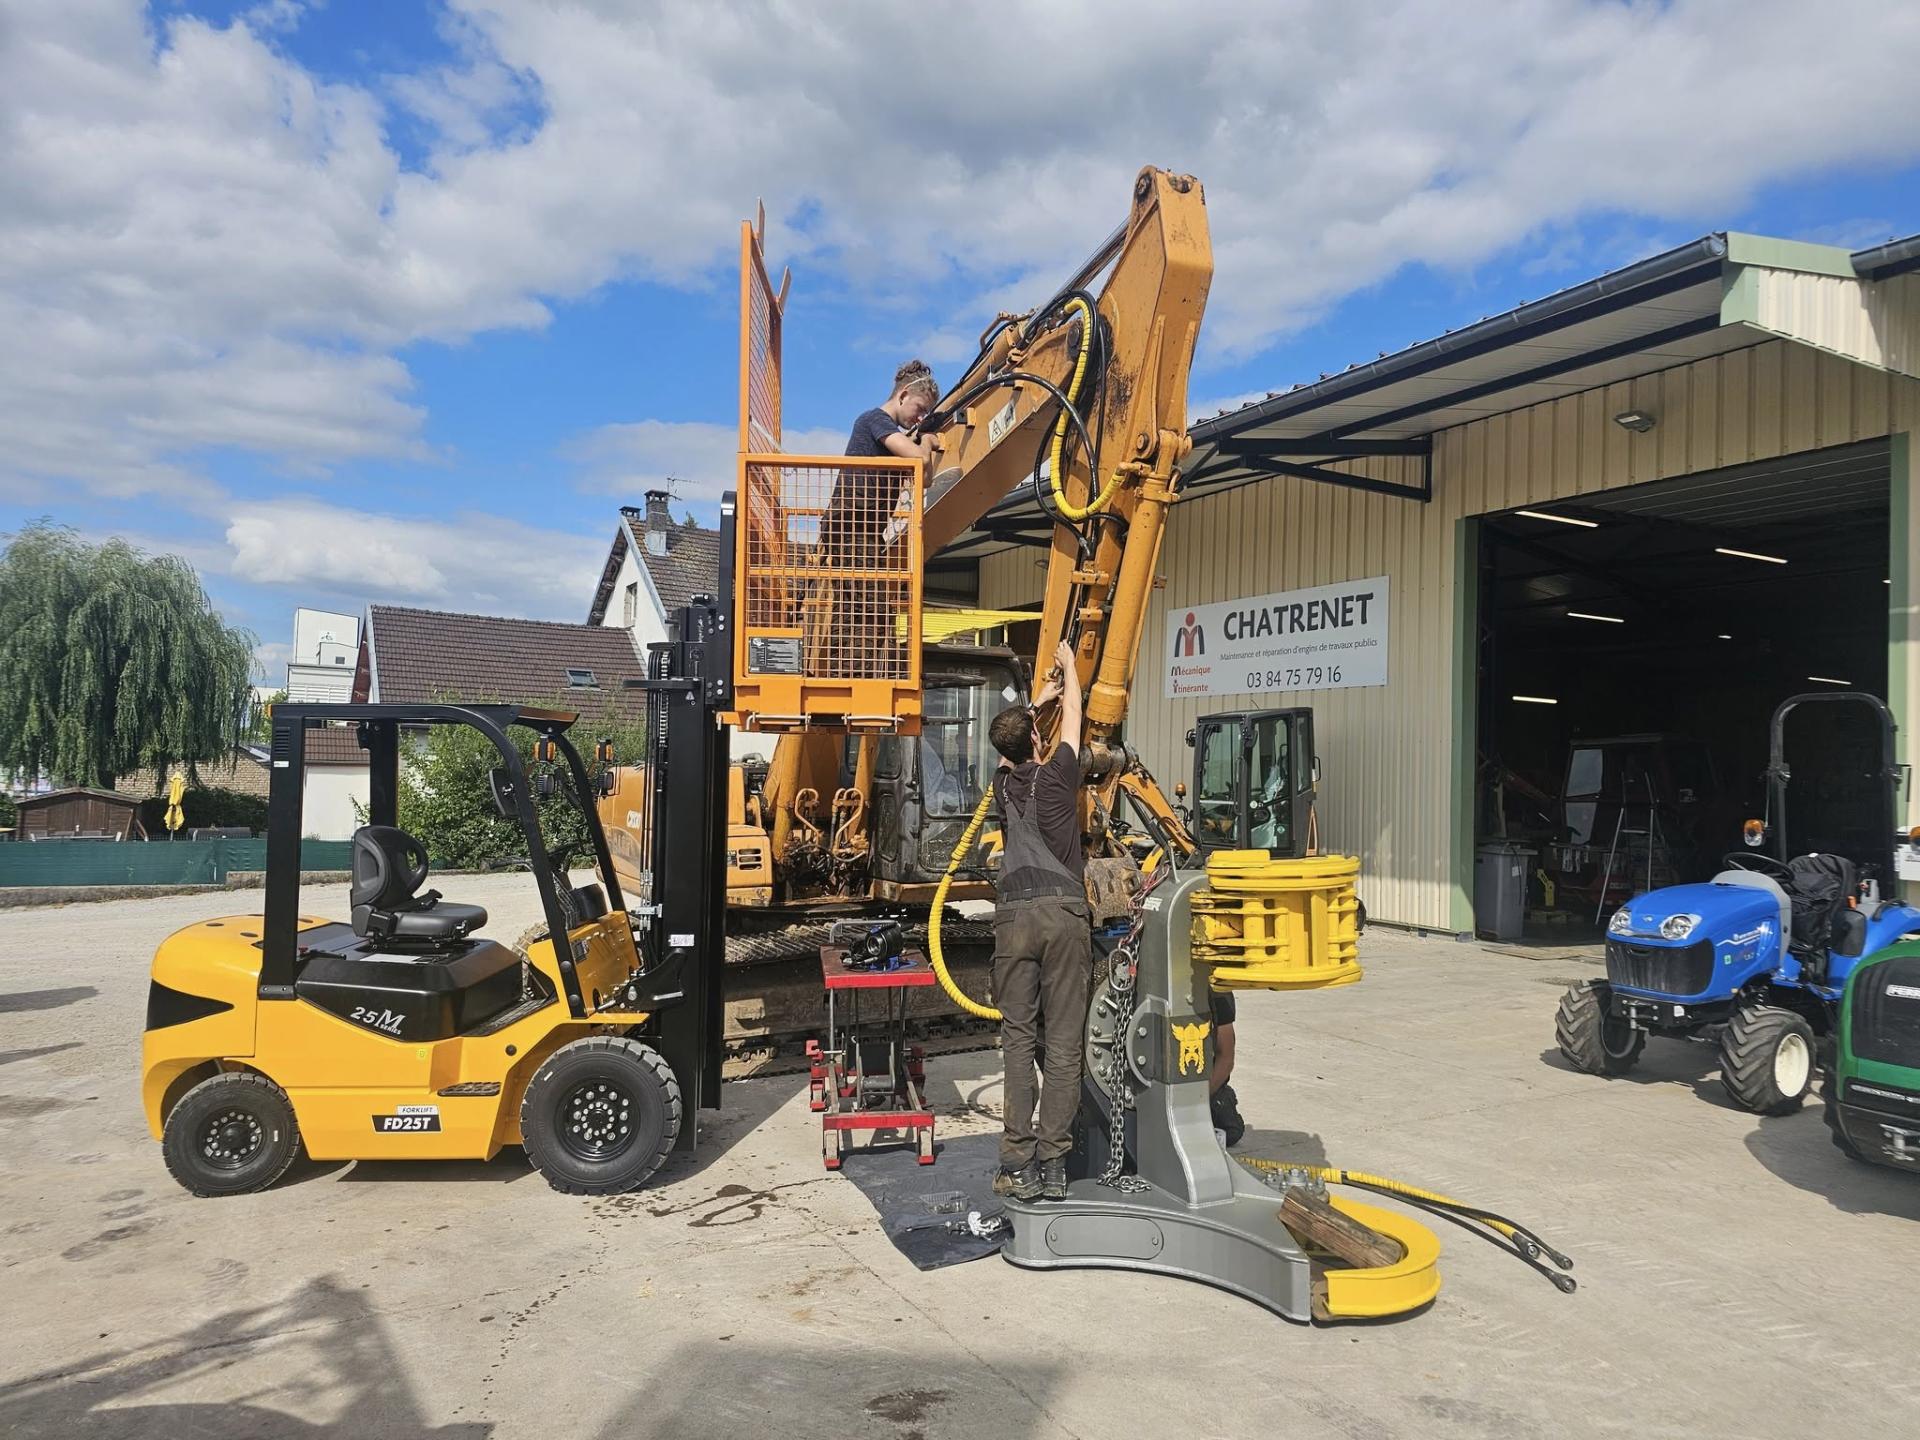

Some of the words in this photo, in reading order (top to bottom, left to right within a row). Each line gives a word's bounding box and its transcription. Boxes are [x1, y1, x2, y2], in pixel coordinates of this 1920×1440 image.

[1223, 592, 1374, 641] CHATRENET
[1319, 643, 1328, 652] de
[1328, 642, 1353, 650] travaux
[1354, 638, 1378, 649] publics
[1247, 672, 1262, 688] 03
[1266, 670, 1282, 687] 84
[1286, 668, 1301, 686] 75
[1306, 666, 1322, 684] 79
[1327, 665, 1342, 683] 16
[383, 1117, 432, 1130] FD25T
